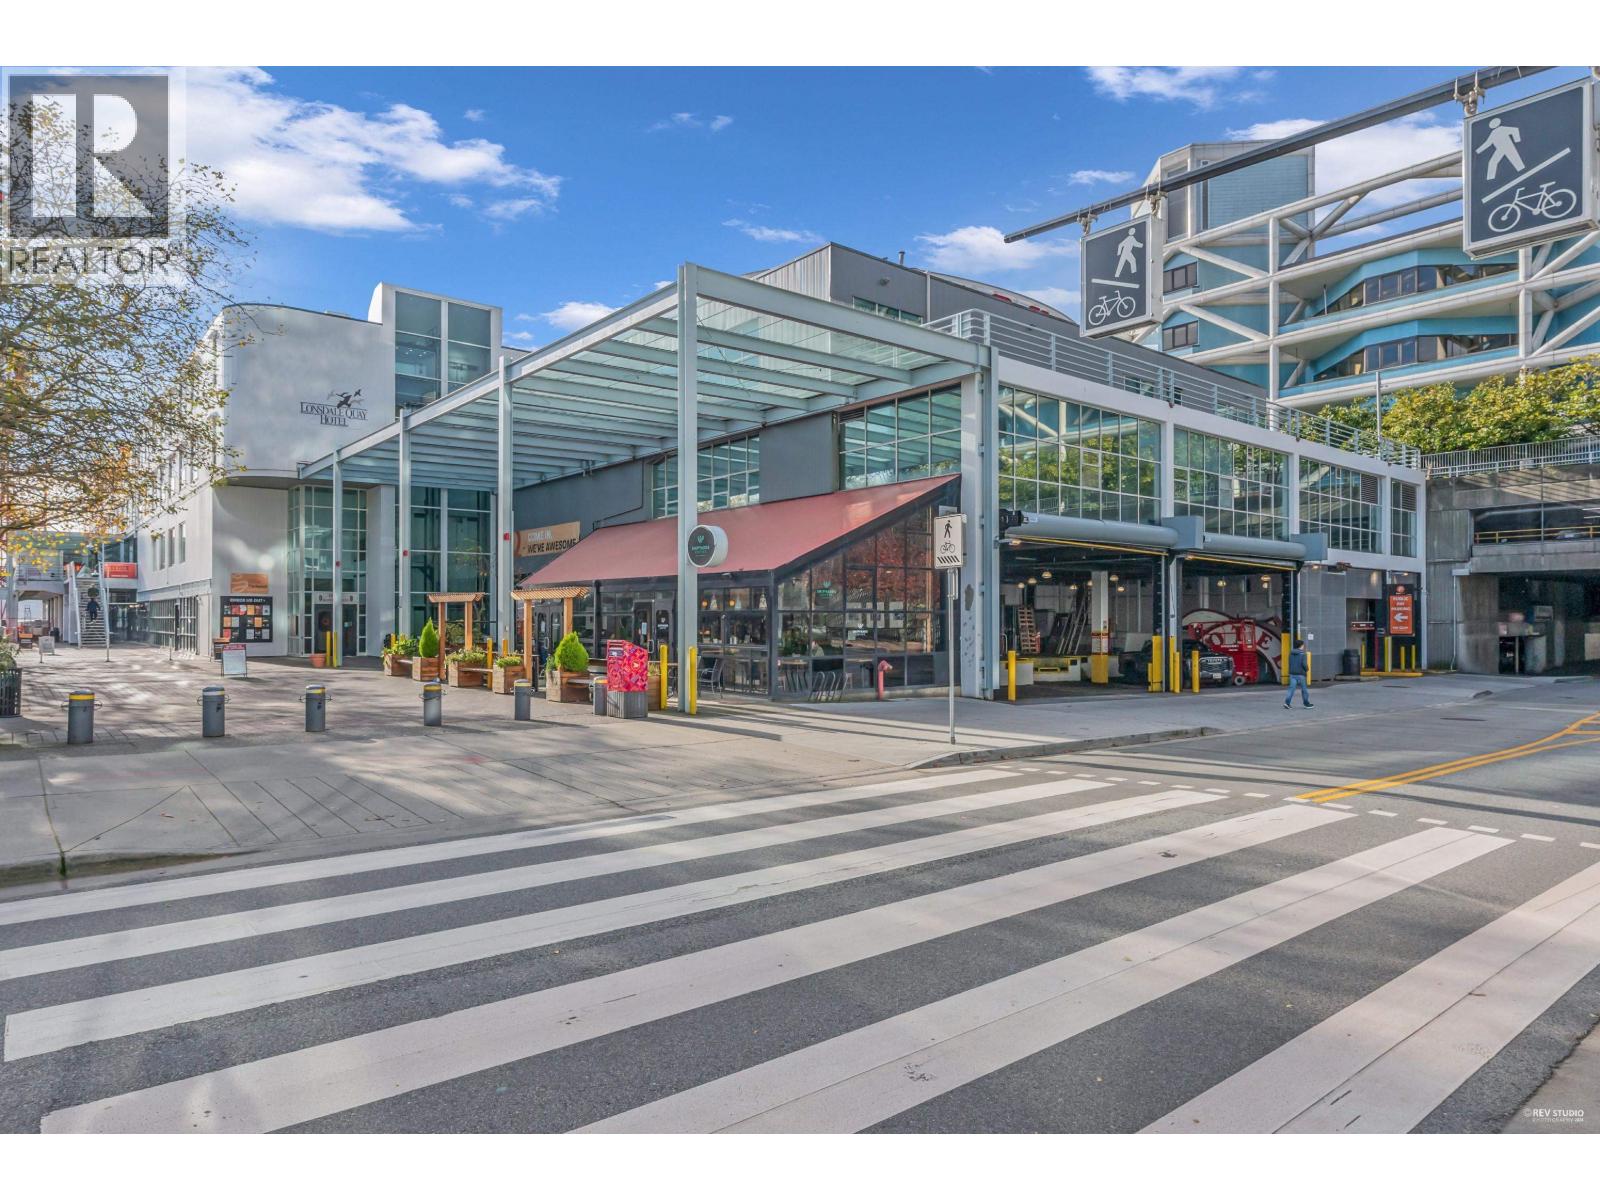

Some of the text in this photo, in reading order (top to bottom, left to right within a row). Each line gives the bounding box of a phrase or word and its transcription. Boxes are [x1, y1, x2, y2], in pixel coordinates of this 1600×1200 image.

[300, 402, 368, 421] LONSDALE QUAY
[320, 414, 348, 427] HOTEL
[545, 538, 577, 552] AWESOME
